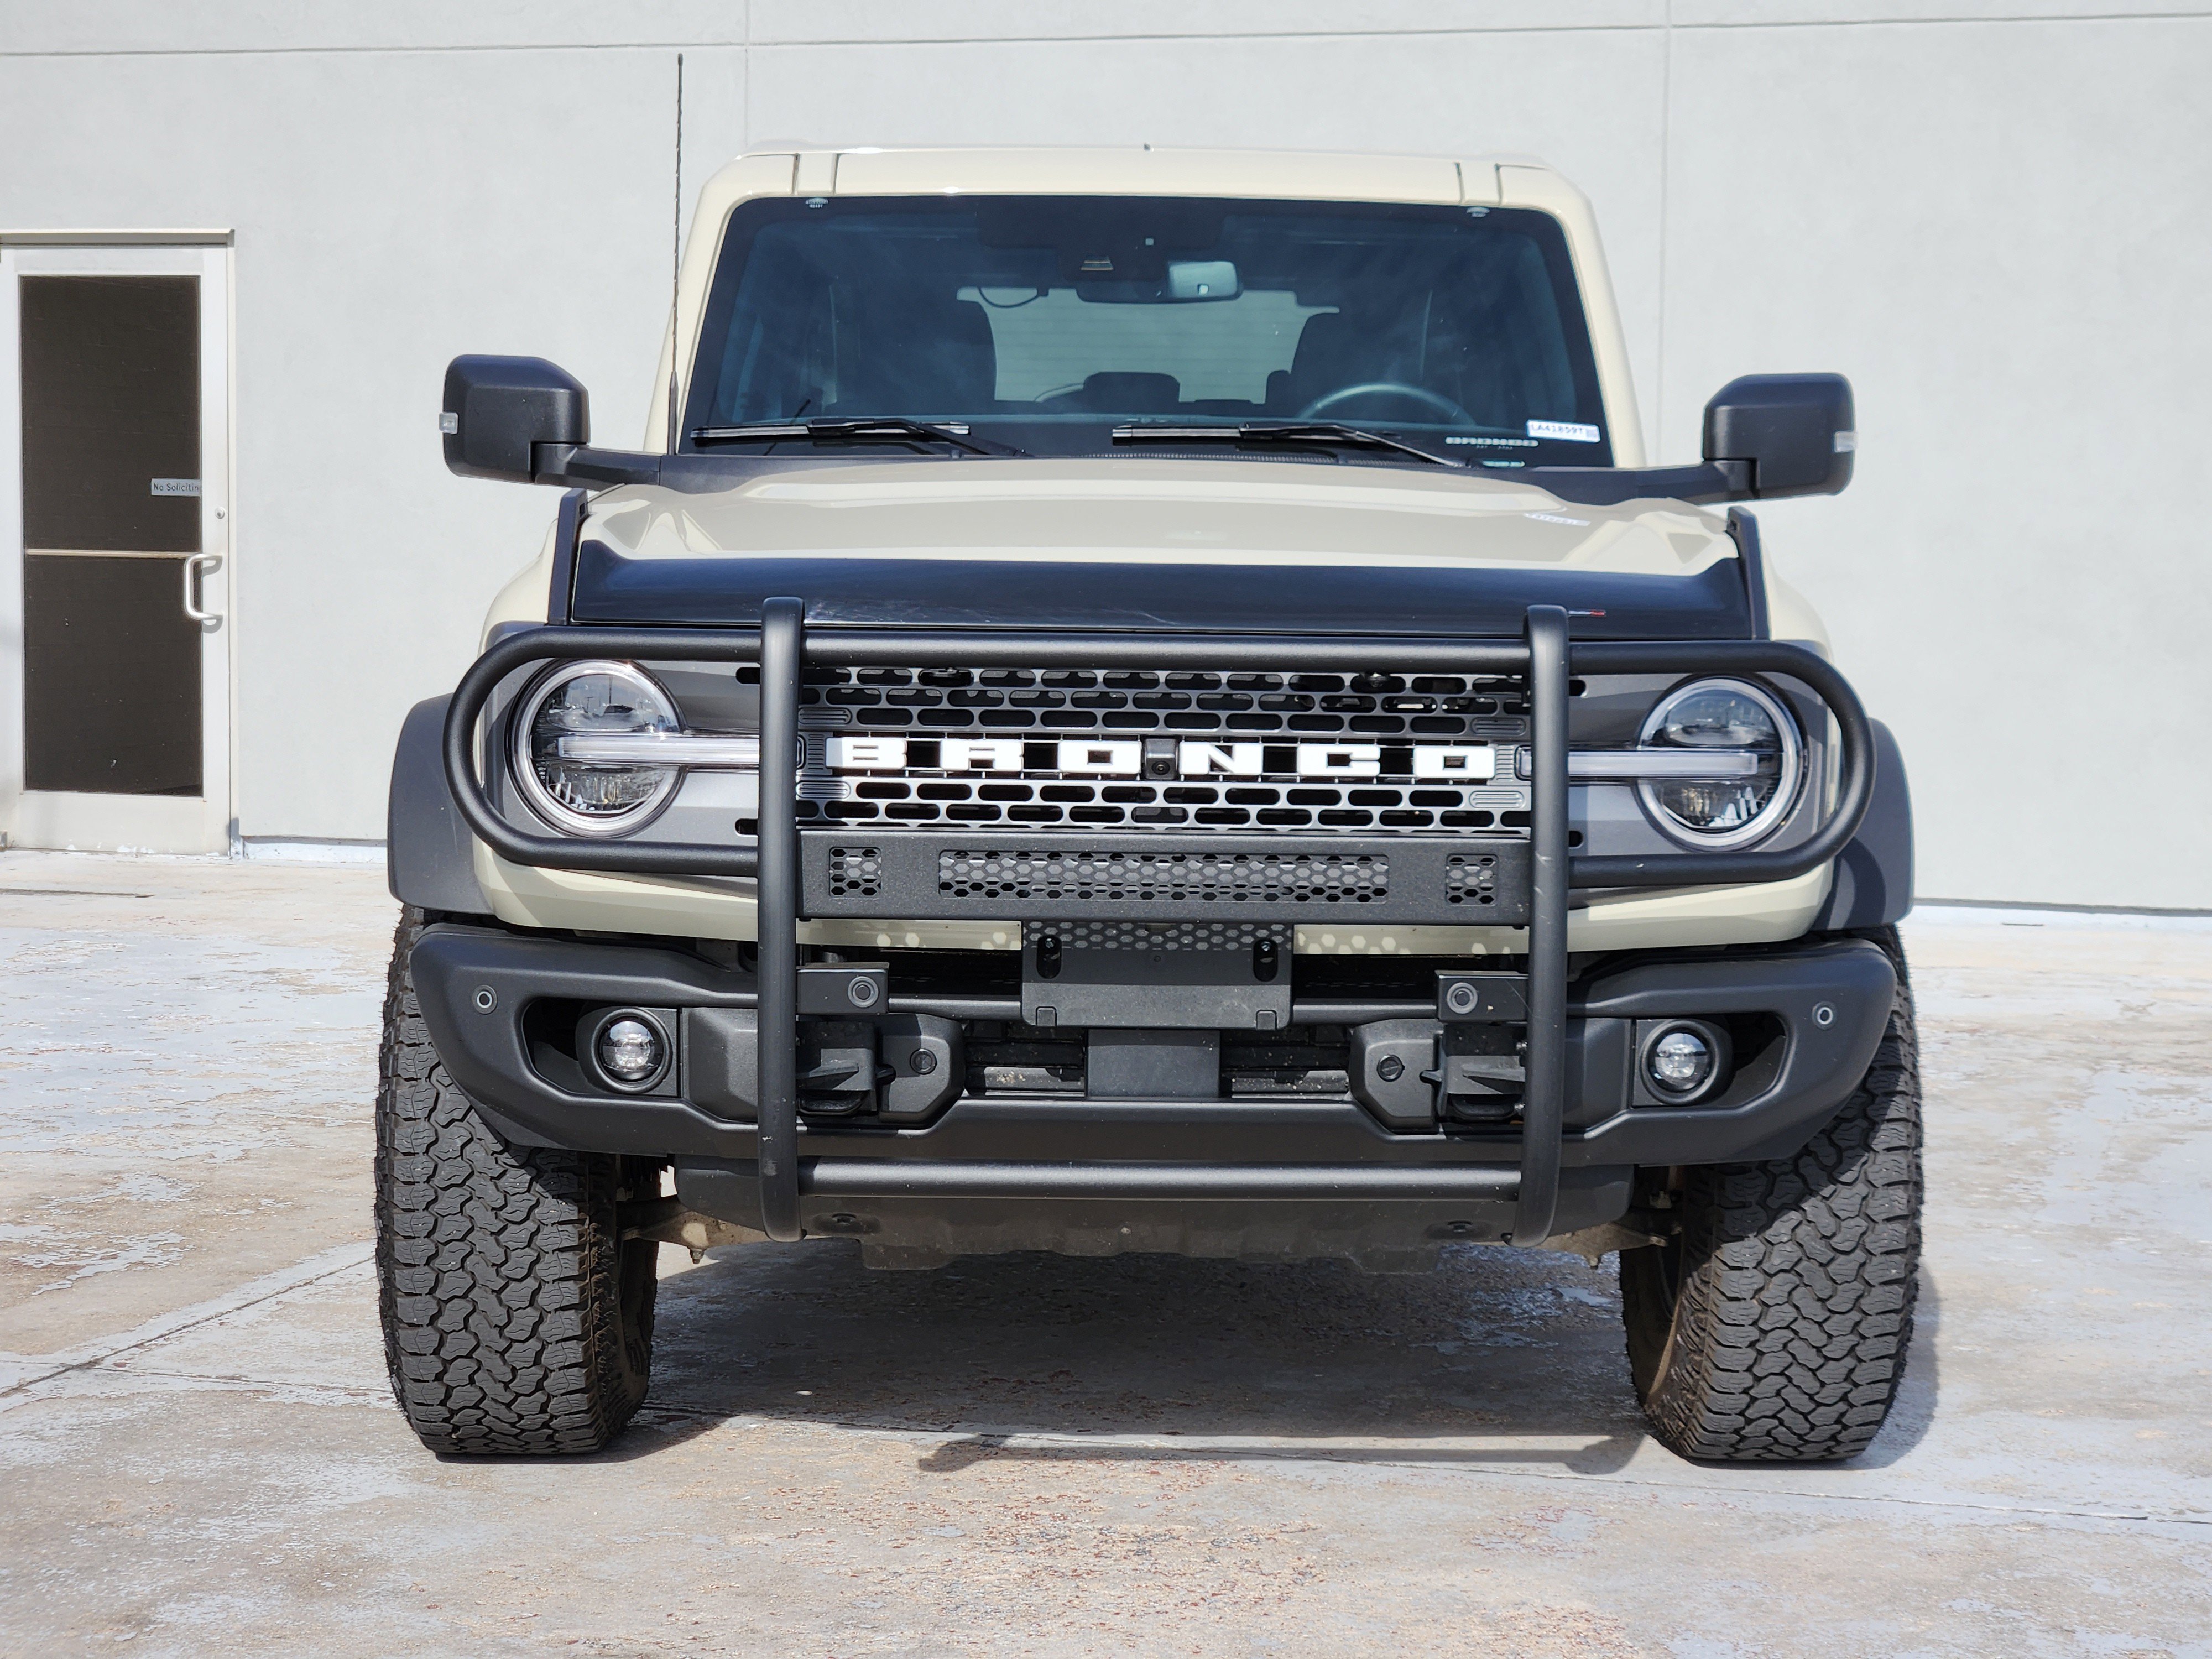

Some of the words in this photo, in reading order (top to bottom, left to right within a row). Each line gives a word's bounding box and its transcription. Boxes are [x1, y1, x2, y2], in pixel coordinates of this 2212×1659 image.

[153, 483, 163, 491] No
[166, 483, 200, 492] Solicitin
[826, 737, 1495, 779] BRONCO
